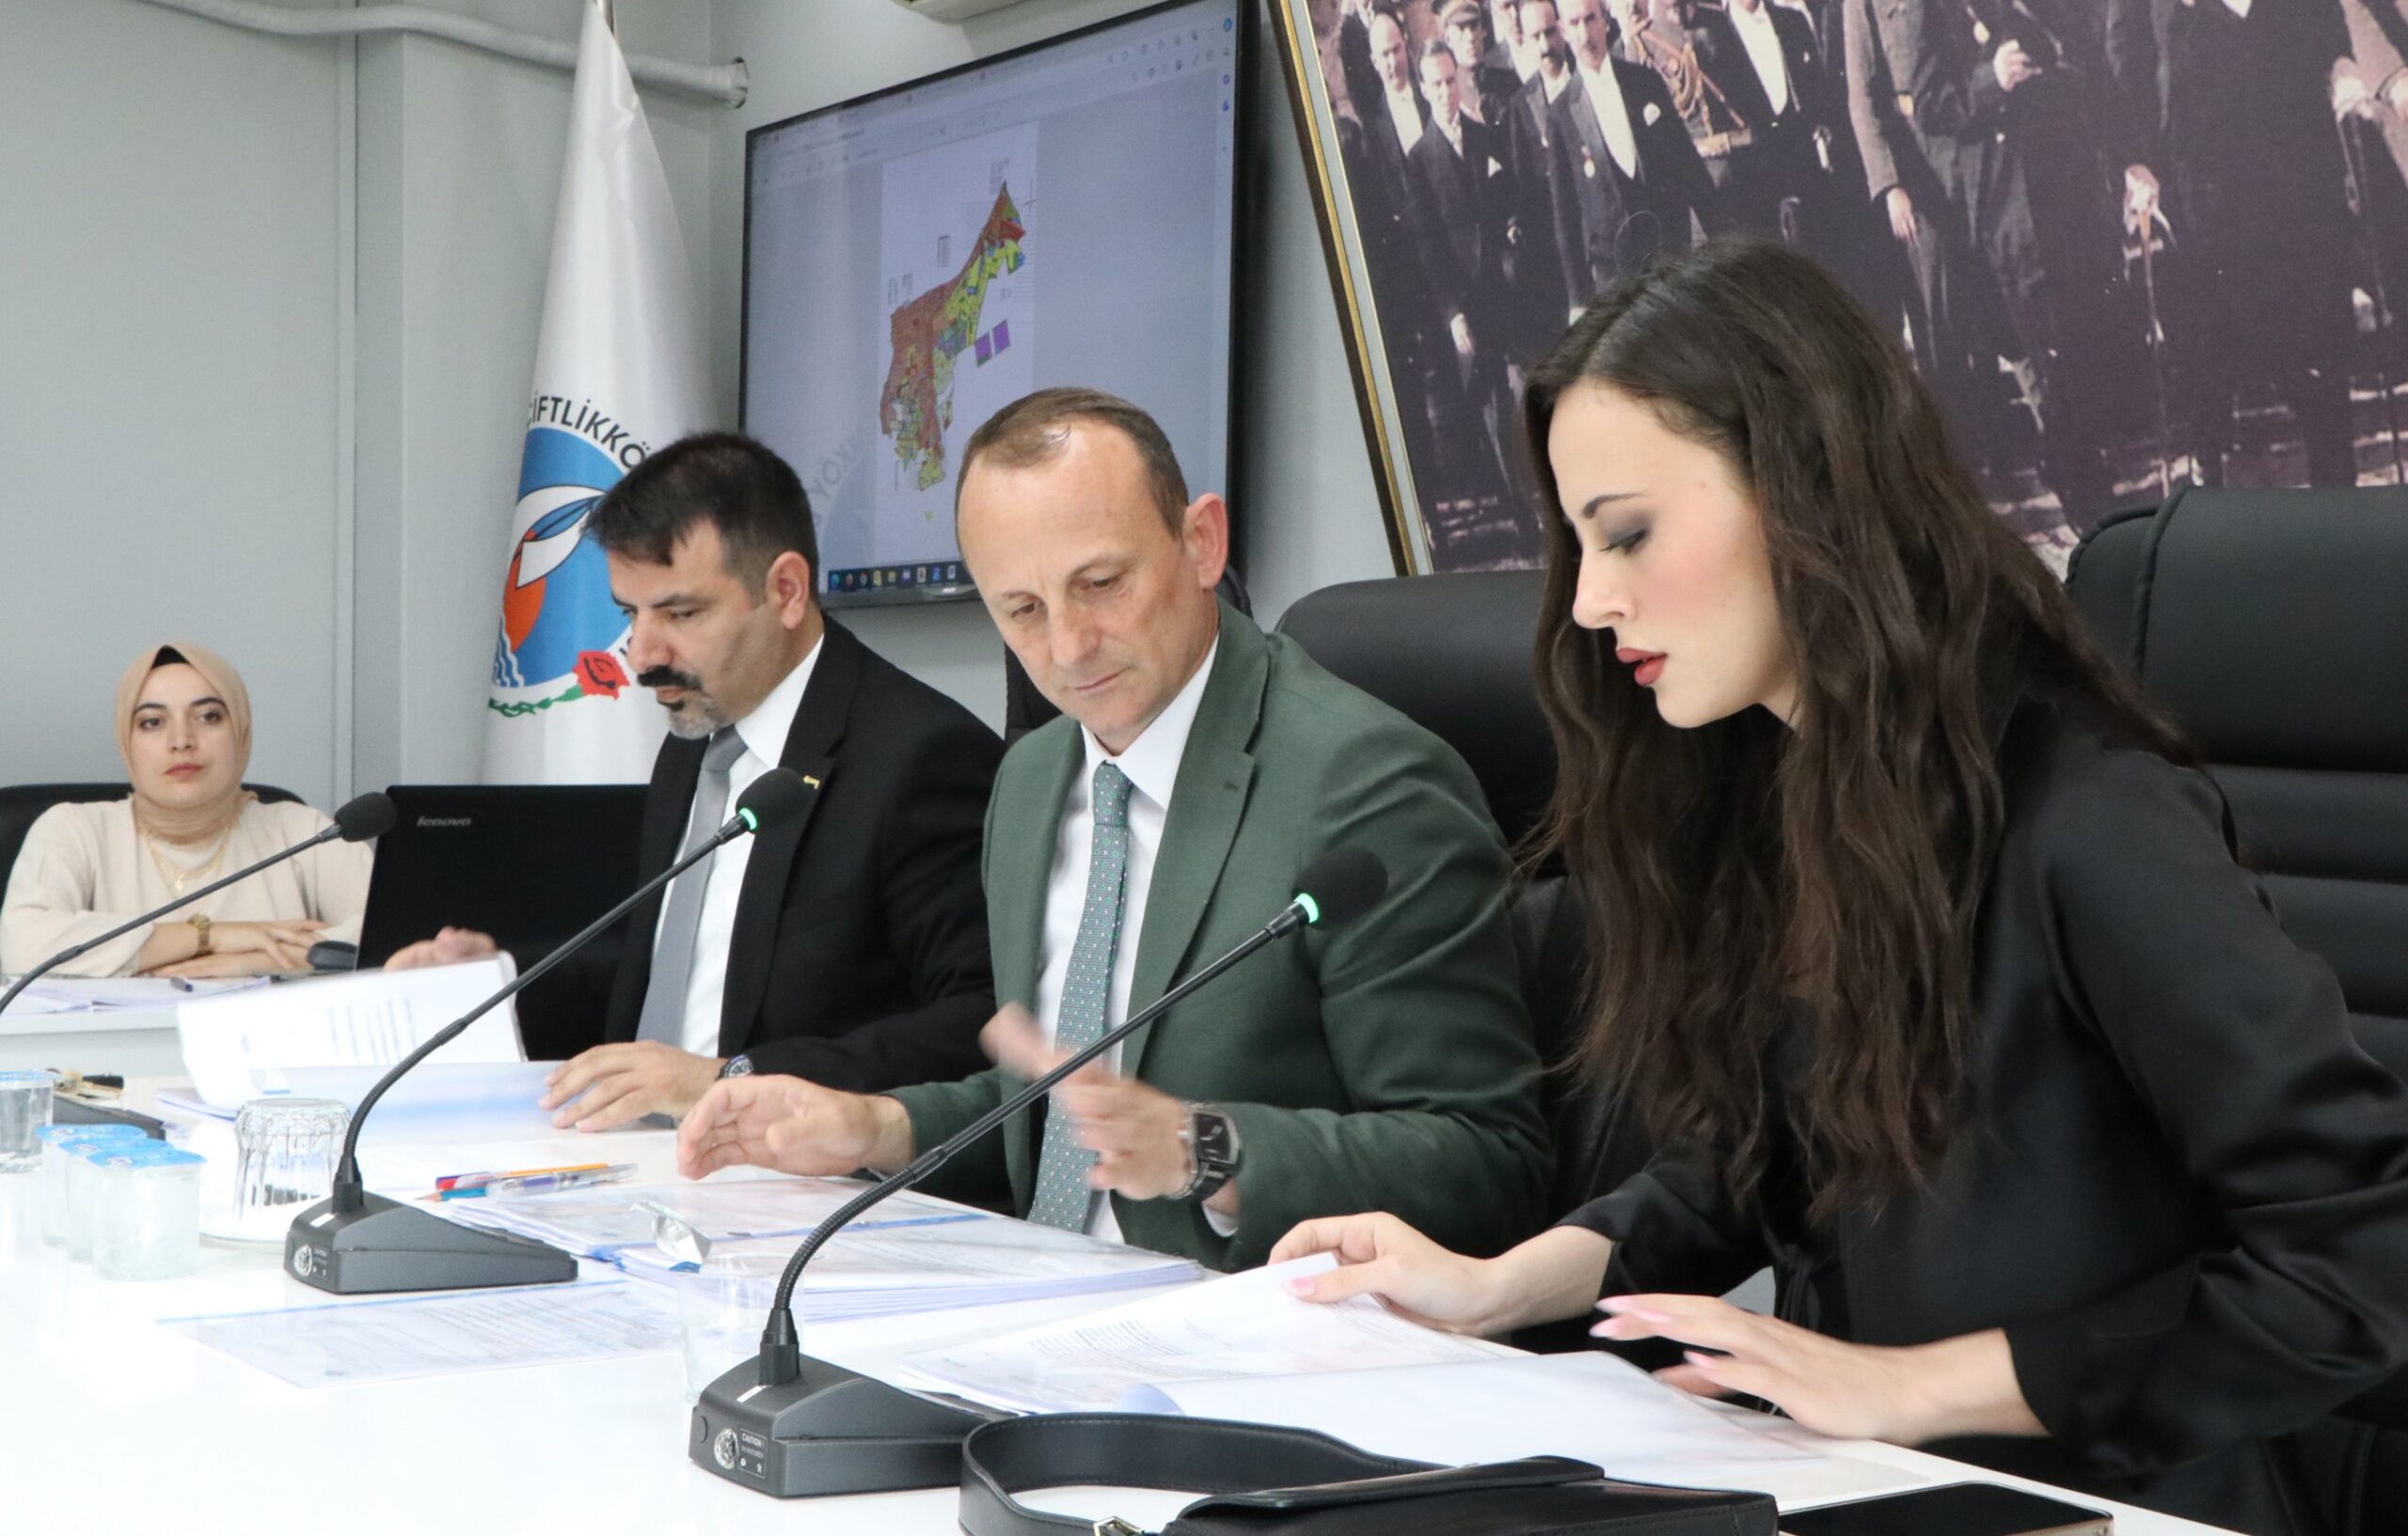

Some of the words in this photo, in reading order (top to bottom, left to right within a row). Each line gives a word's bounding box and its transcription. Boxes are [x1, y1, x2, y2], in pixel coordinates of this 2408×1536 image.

[527, 390, 650, 469] İFTLİKKÖ
[417, 816, 471, 827] lenovo
[741, 1433, 762, 1448] CAUTION
